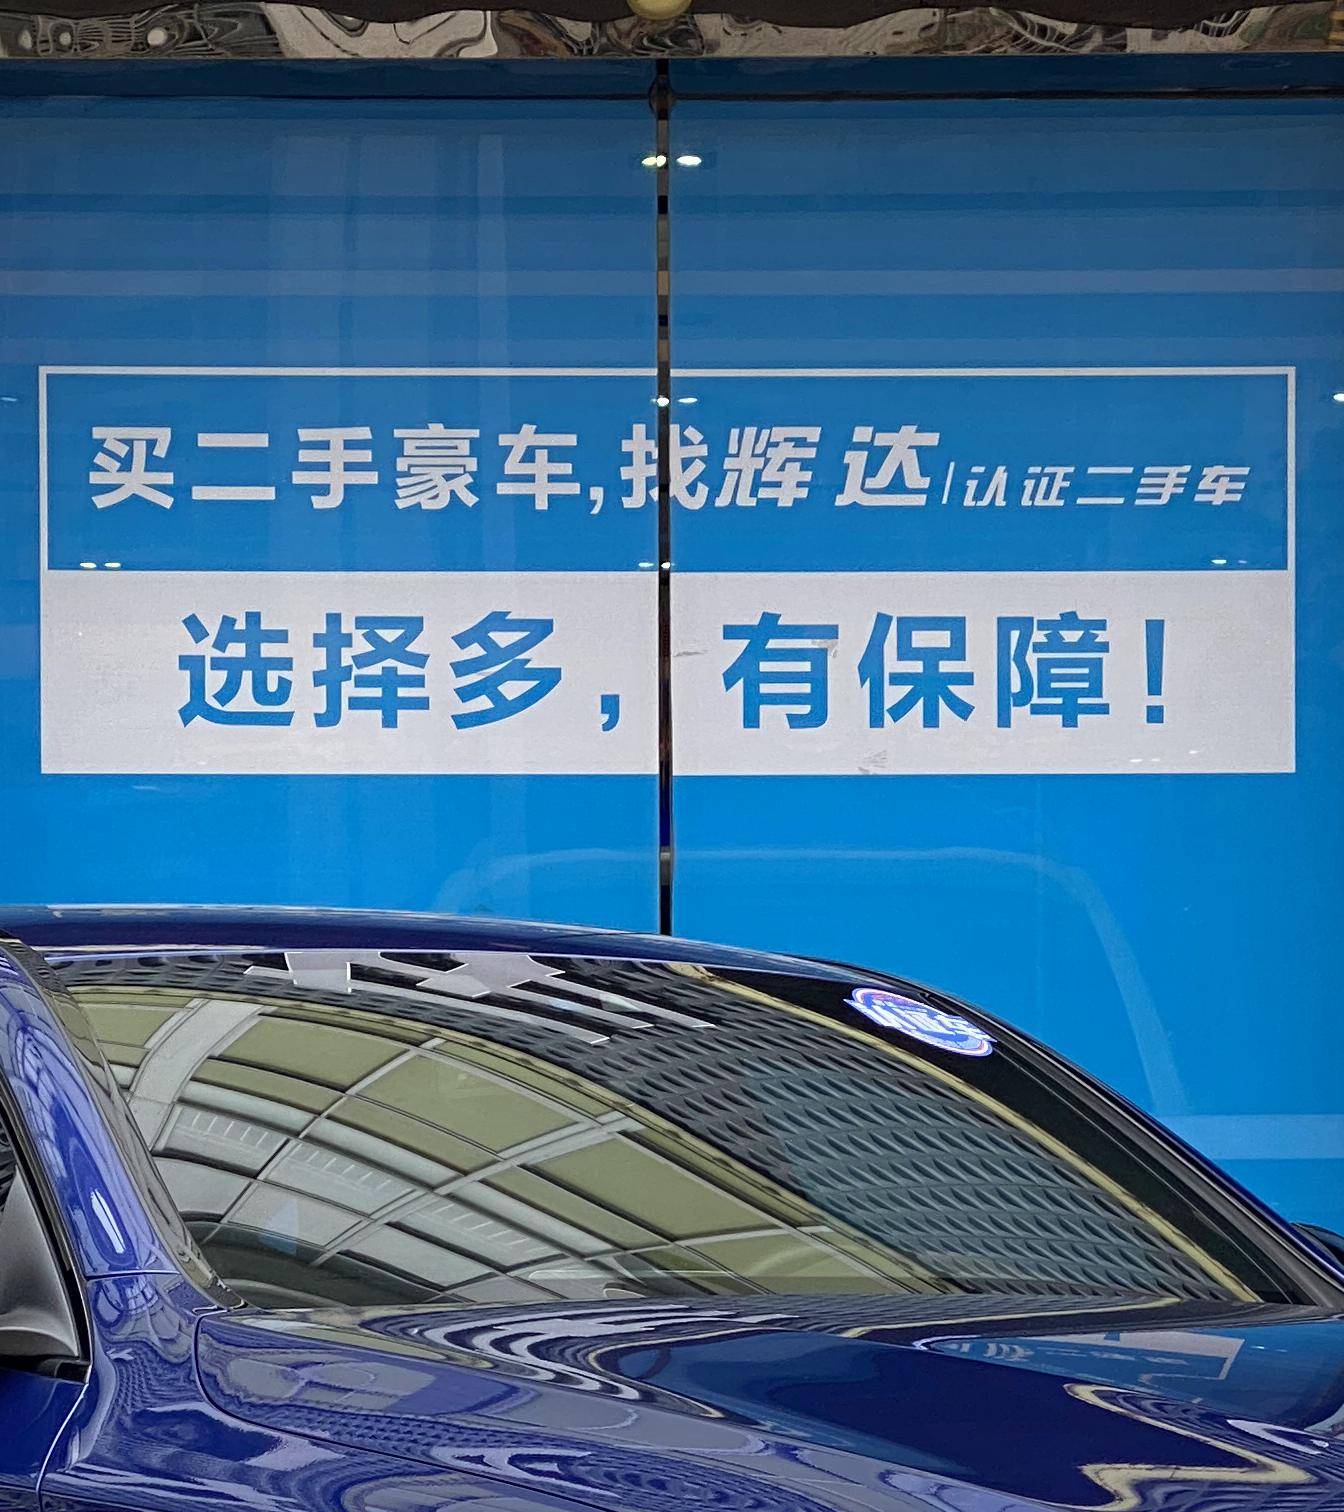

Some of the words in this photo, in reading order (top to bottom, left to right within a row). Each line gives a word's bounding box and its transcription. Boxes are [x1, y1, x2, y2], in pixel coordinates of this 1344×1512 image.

[963, 465, 1250, 507] 认证二手车
